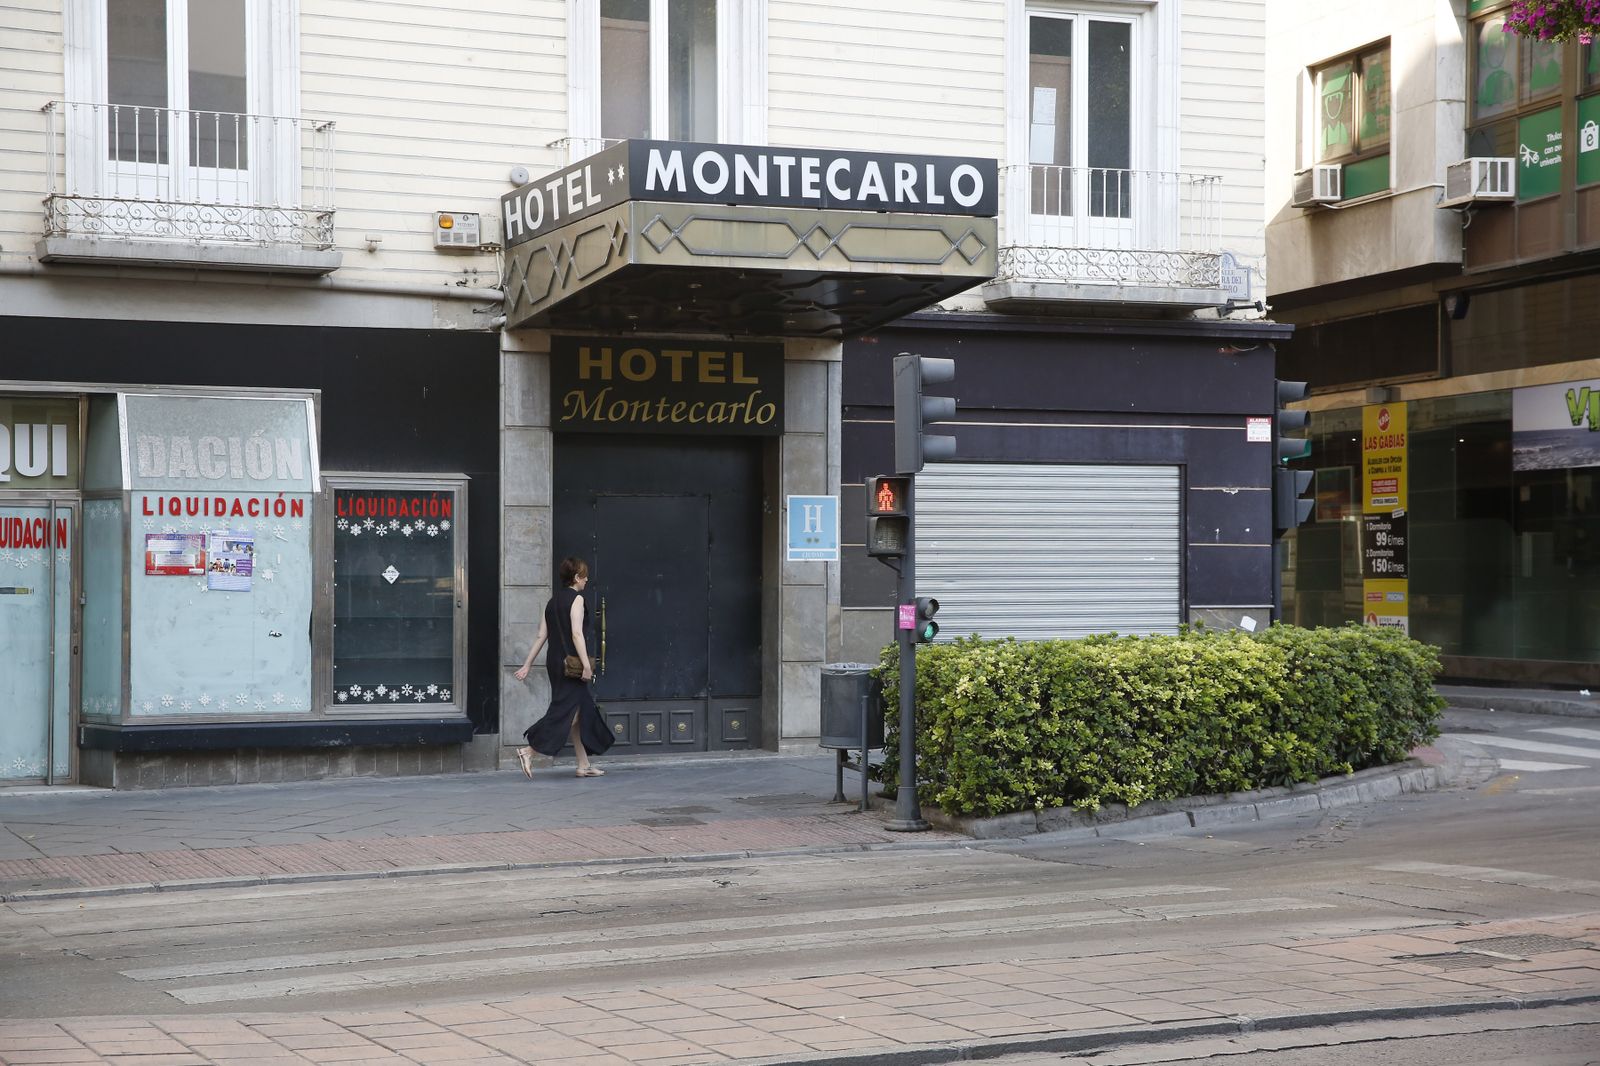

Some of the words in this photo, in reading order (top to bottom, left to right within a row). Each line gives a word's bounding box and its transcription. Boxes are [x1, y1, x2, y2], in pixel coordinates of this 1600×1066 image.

[644, 148, 985, 208] MONTECARLO
[504, 163, 602, 241] HOTEL
[578, 346, 760, 385] HOTEL
[560, 386, 777, 426] Montecarlo
[136, 430, 304, 480] DACIÓN
[1364, 437, 1377, 451] LAS
[1379, 434, 1405, 449] GABIAS
[142, 492, 304, 518] LIQUIDACIÓN
[337, 492, 453, 518] LIQUIDACIÓN
[803, 504, 824, 532] H
[1369, 522, 1392, 531] Dormitorio
[1376, 532, 1387, 546] 99
[1372, 558, 1387, 573] 150
